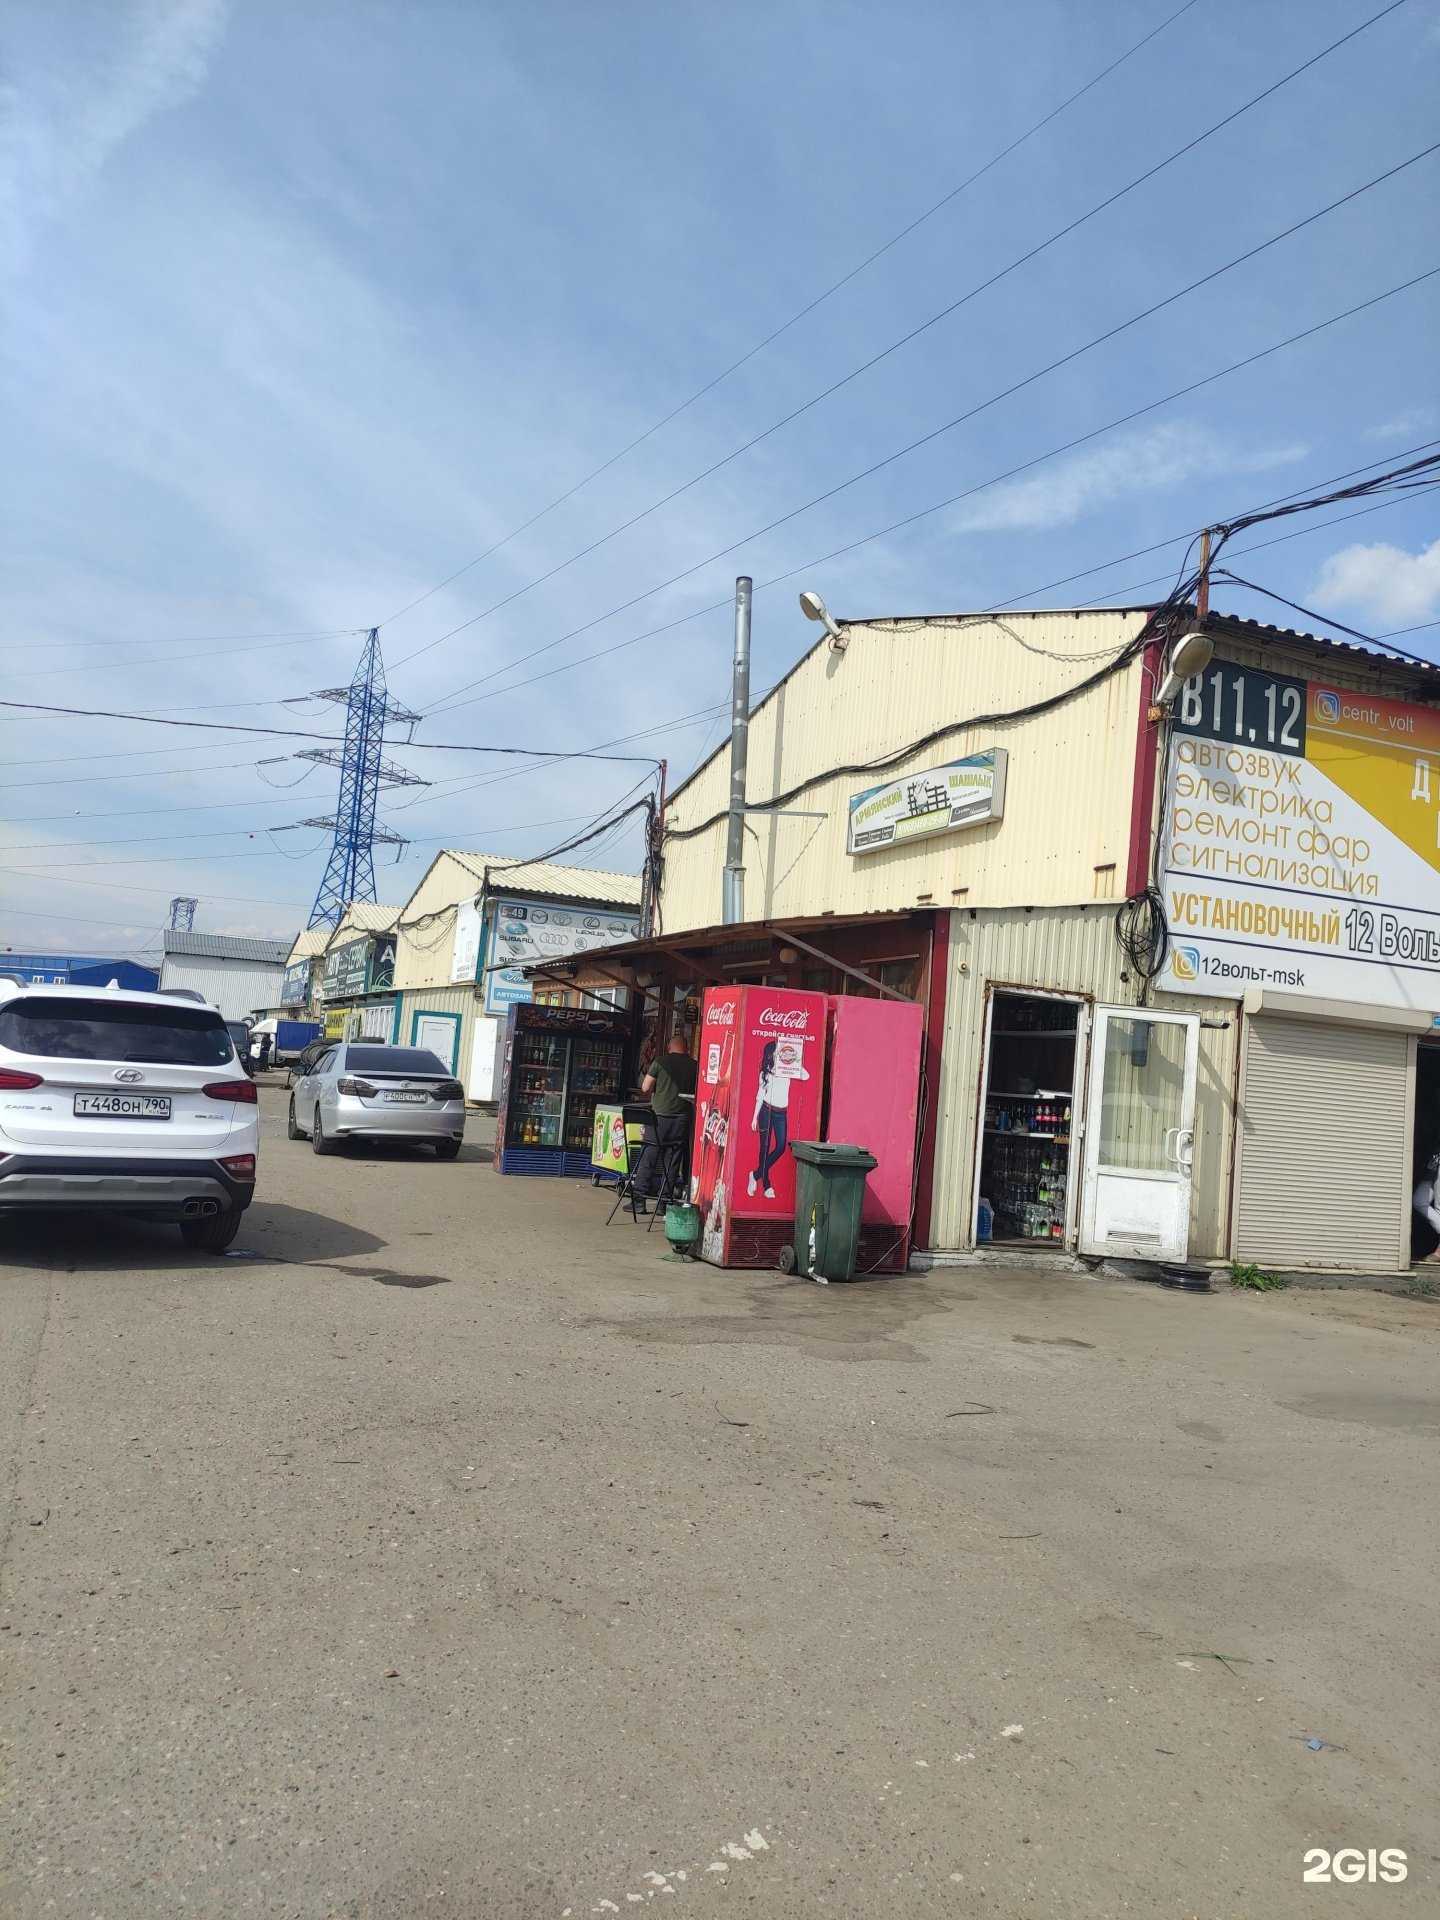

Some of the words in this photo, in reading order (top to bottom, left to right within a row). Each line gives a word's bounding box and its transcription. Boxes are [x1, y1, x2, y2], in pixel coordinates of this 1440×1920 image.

[1342, 706, 1415, 733] centr_volt
[1176, 740, 1302, 787] автозвук
[1174, 773, 1333, 824] электрика
[1172, 807, 1291, 849] ремонт
[1297, 824, 1370, 867] фар
[1171, 842, 1379, 896] сигнализация
[499, 936, 534, 944] SUBARU
[1172, 891, 1340, 946] УСТАНОВОЧНЫЙ
[1345, 908, 1375, 954] 12
[1201, 956, 1305, 987] 12вольт-msk
[546, 1009, 590, 1021] PEPSI
[144, 1099, 166, 1110] 790
